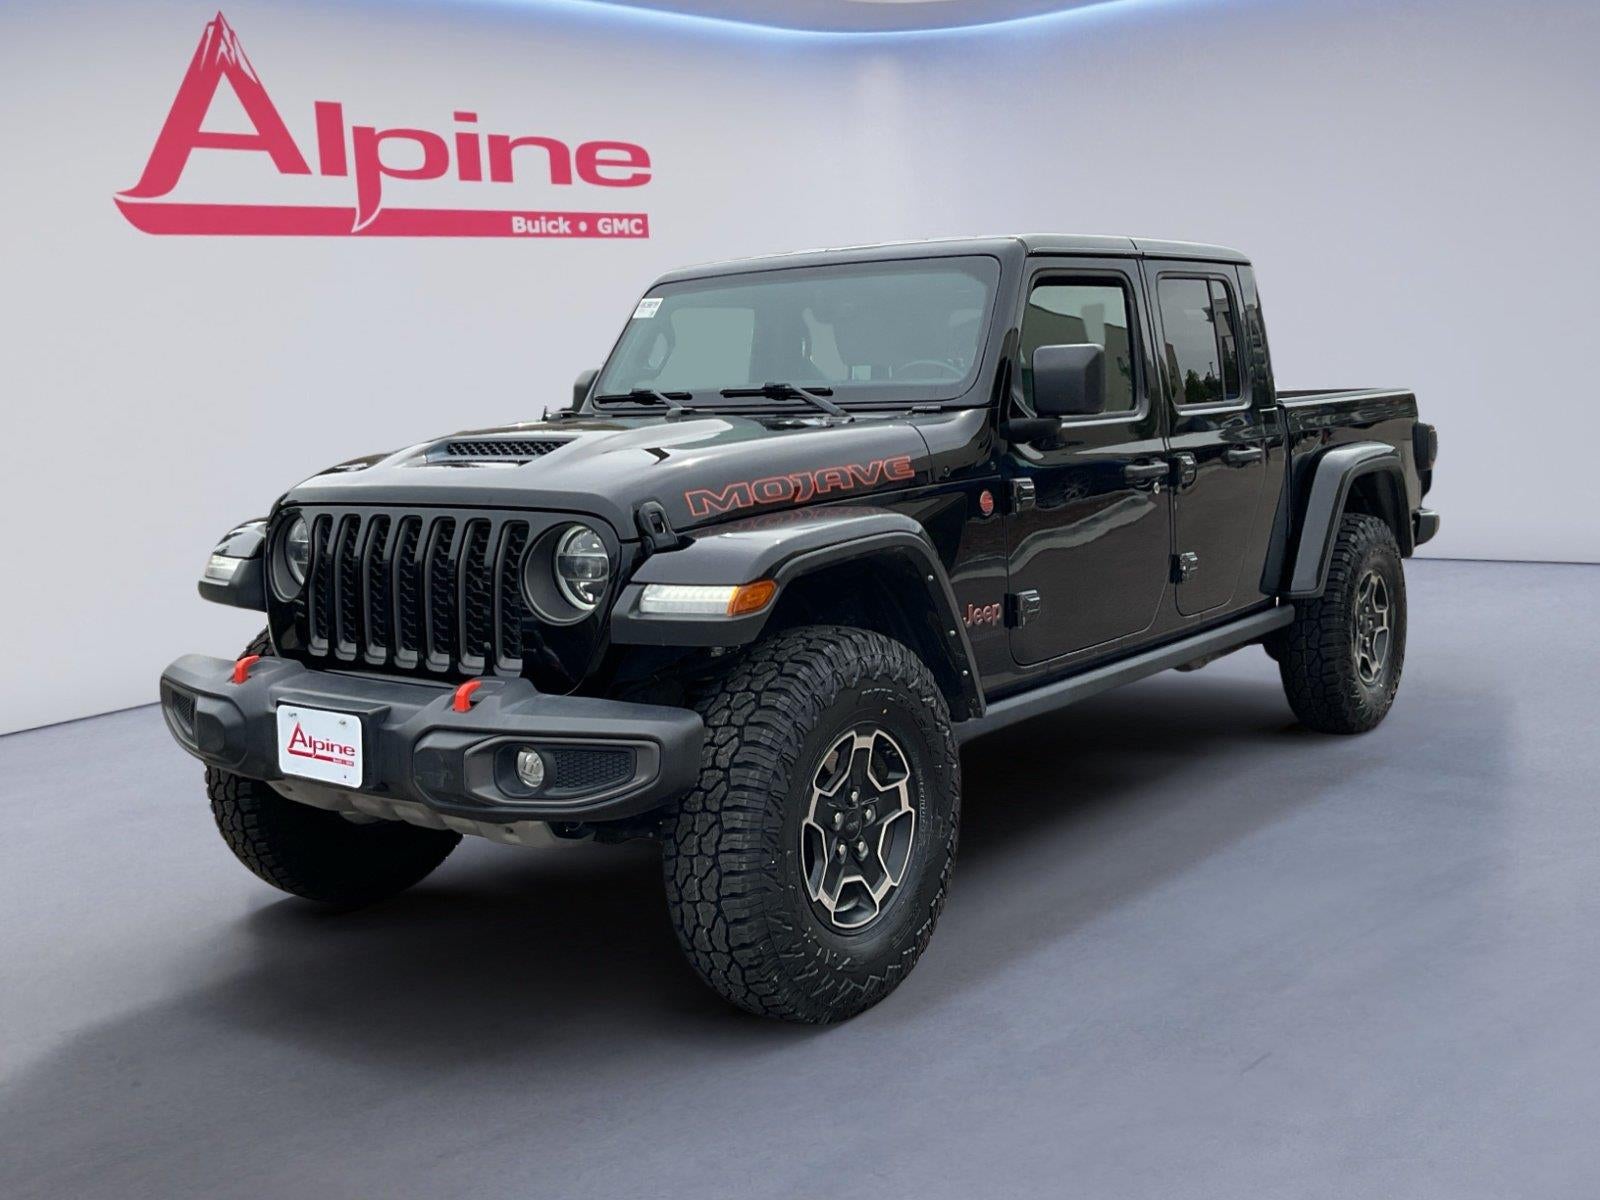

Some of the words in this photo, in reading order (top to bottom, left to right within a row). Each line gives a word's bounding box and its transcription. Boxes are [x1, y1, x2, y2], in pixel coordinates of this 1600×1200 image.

[114, 10, 652, 233] Alpine
[511, 216, 571, 233] Buick
[597, 217, 643, 234] GMC
[685, 456, 915, 516] MOJAVE
[963, 602, 1002, 627] Jeep
[288, 721, 355, 758] Alpine
